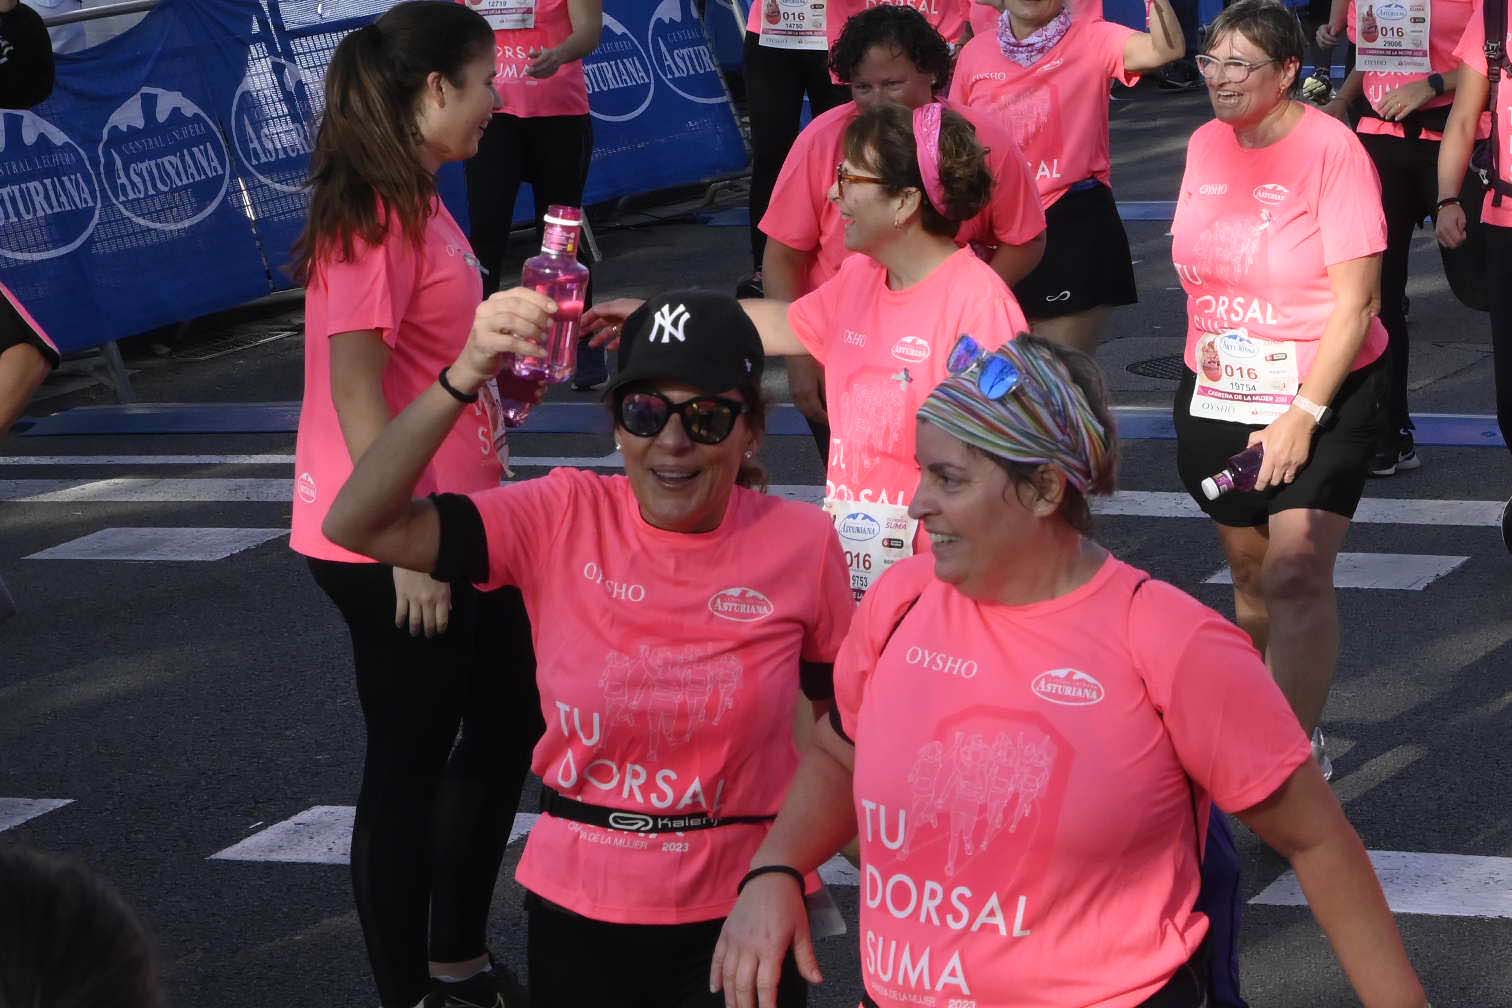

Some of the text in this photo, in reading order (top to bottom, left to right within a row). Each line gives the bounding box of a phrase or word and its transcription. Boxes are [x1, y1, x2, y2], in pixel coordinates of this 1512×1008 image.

[783, 11, 805, 21] 016
[1380, 27, 1404, 37] 016
[111, 142, 224, 202] ASTURIANA
[649, 304, 691, 343] NY
[1225, 365, 1258, 379] 016
[714, 597, 771, 614] ASTURIANA
[906, 646, 978, 679] OYSHO
[1036, 678, 1099, 700] ASTURIANA
[555, 701, 599, 746] TU
[862, 799, 906, 850] TU
[662, 842, 689, 852] 2023
[866, 863, 1032, 938] DORSAL
[866, 930, 971, 995] SUMA
